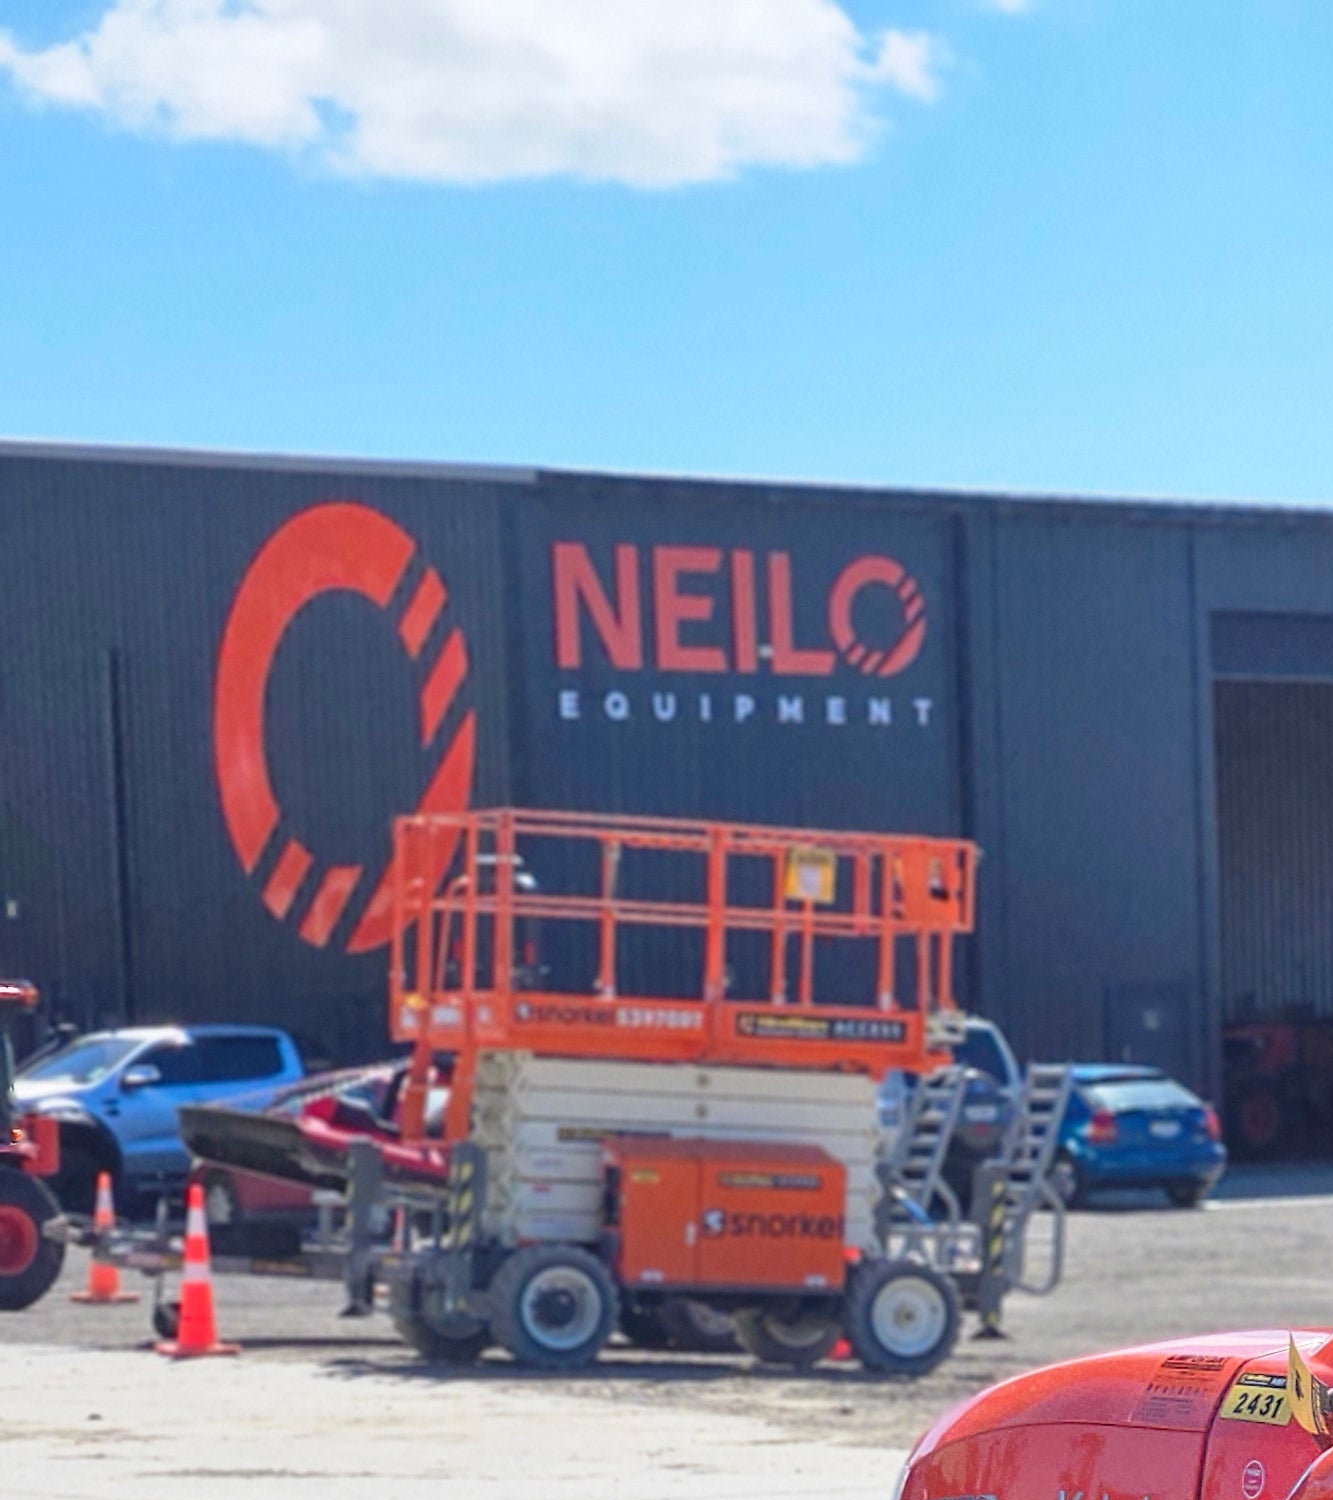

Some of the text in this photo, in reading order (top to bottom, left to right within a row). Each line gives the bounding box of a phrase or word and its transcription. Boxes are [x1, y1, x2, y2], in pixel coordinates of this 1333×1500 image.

[552, 541, 928, 678] NEILO
[559, 689, 936, 726] EQUIPMENT
[730, 1210, 846, 1240] snorkel
[1232, 1391, 1285, 1419] 2431
